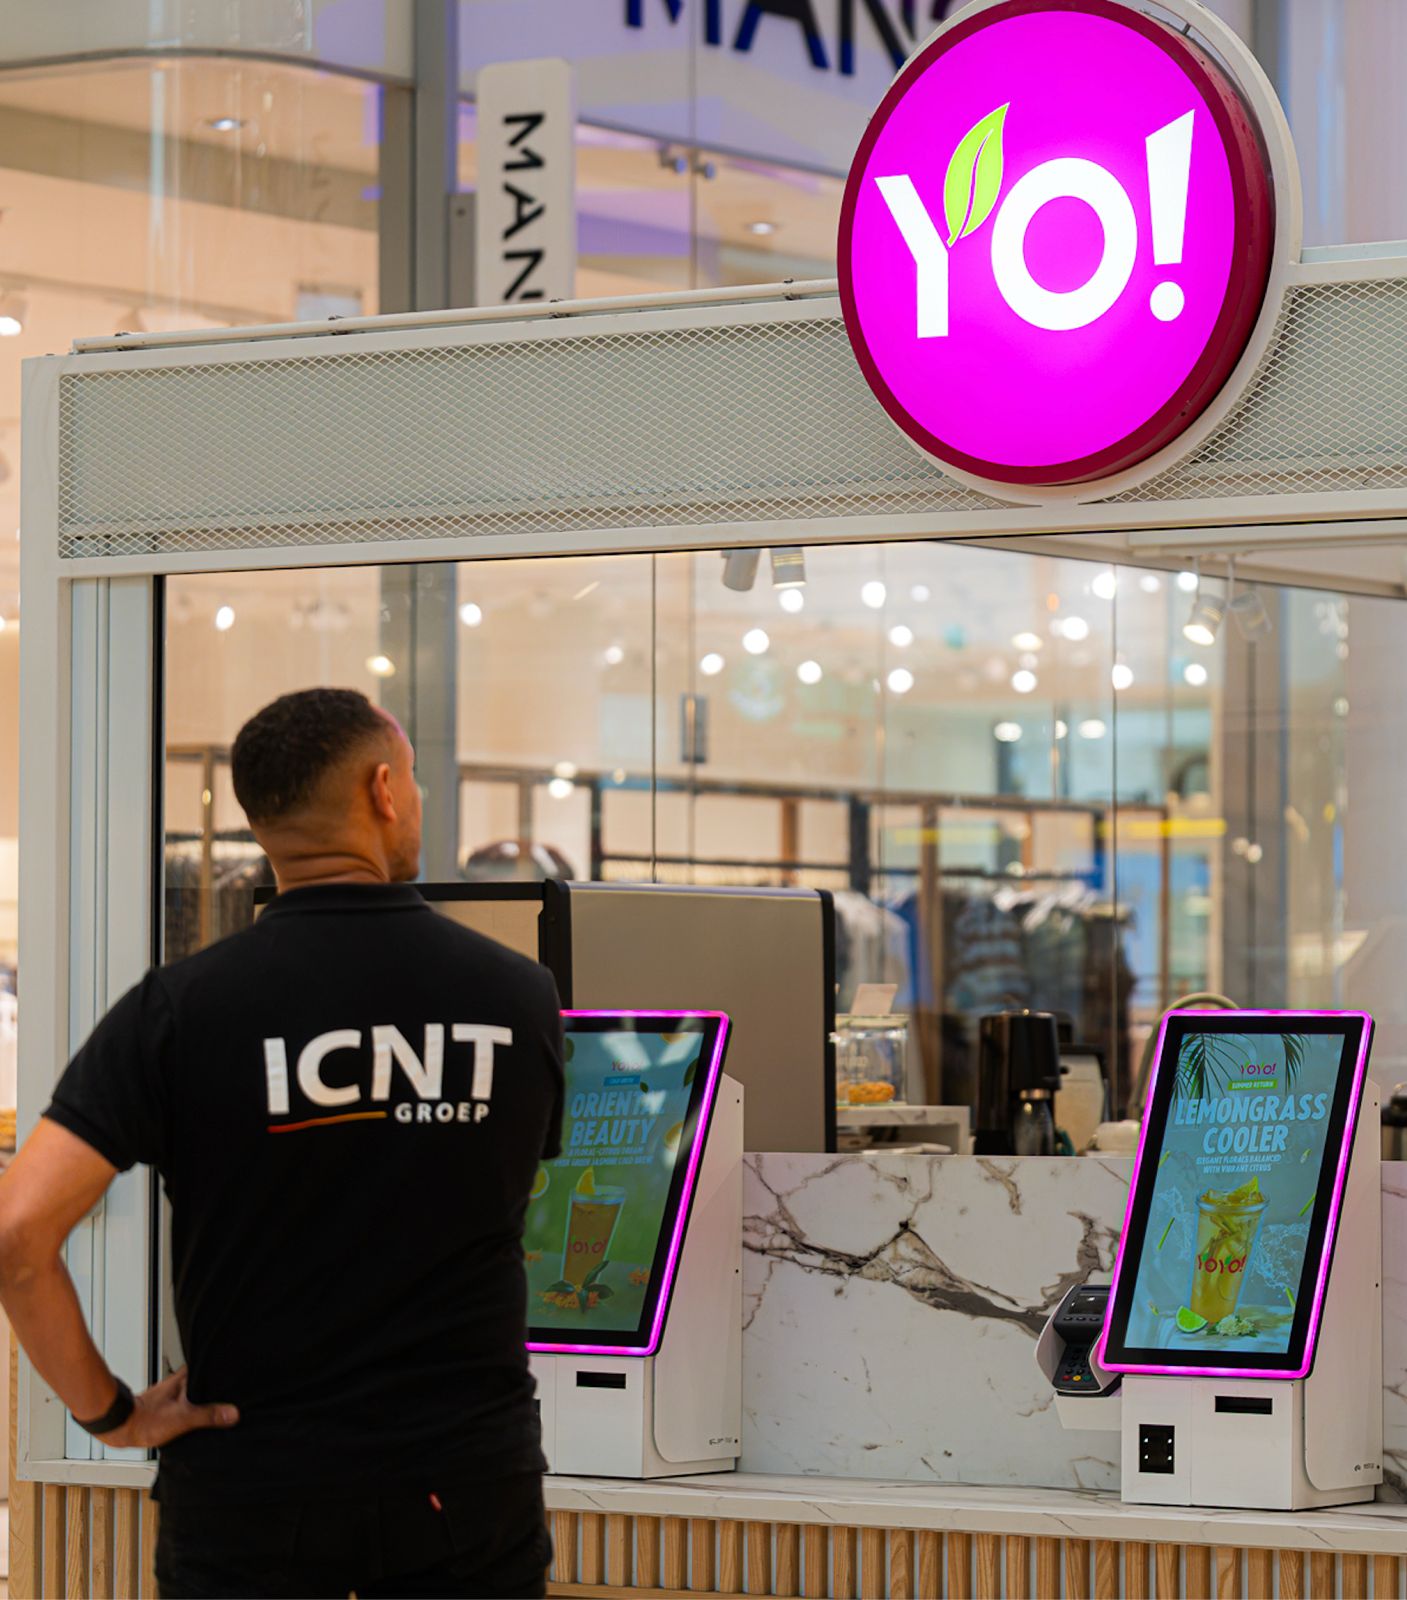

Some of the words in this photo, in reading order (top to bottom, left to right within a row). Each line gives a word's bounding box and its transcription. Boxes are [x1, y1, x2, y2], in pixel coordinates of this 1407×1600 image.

[873, 107, 1195, 340] YO!
[263, 1023, 513, 1116] ICNT
[1240, 1062, 1277, 1075] YOYO!
[394, 1102, 490, 1124] GROEP
[1174, 1092, 1328, 1125] LEMONGRASS
[569, 1116, 658, 1147] BEAUTY
[1203, 1124, 1289, 1154] COOLER
[1203, 1165, 1221, 1174] WITH
[1221, 1164, 1249, 1173] VIBRANT
[1249, 1163, 1272, 1172] CITRUS
[1249, 1154, 1282, 1162] BALANCED
[1197, 1253, 1247, 1275] YOYO!
